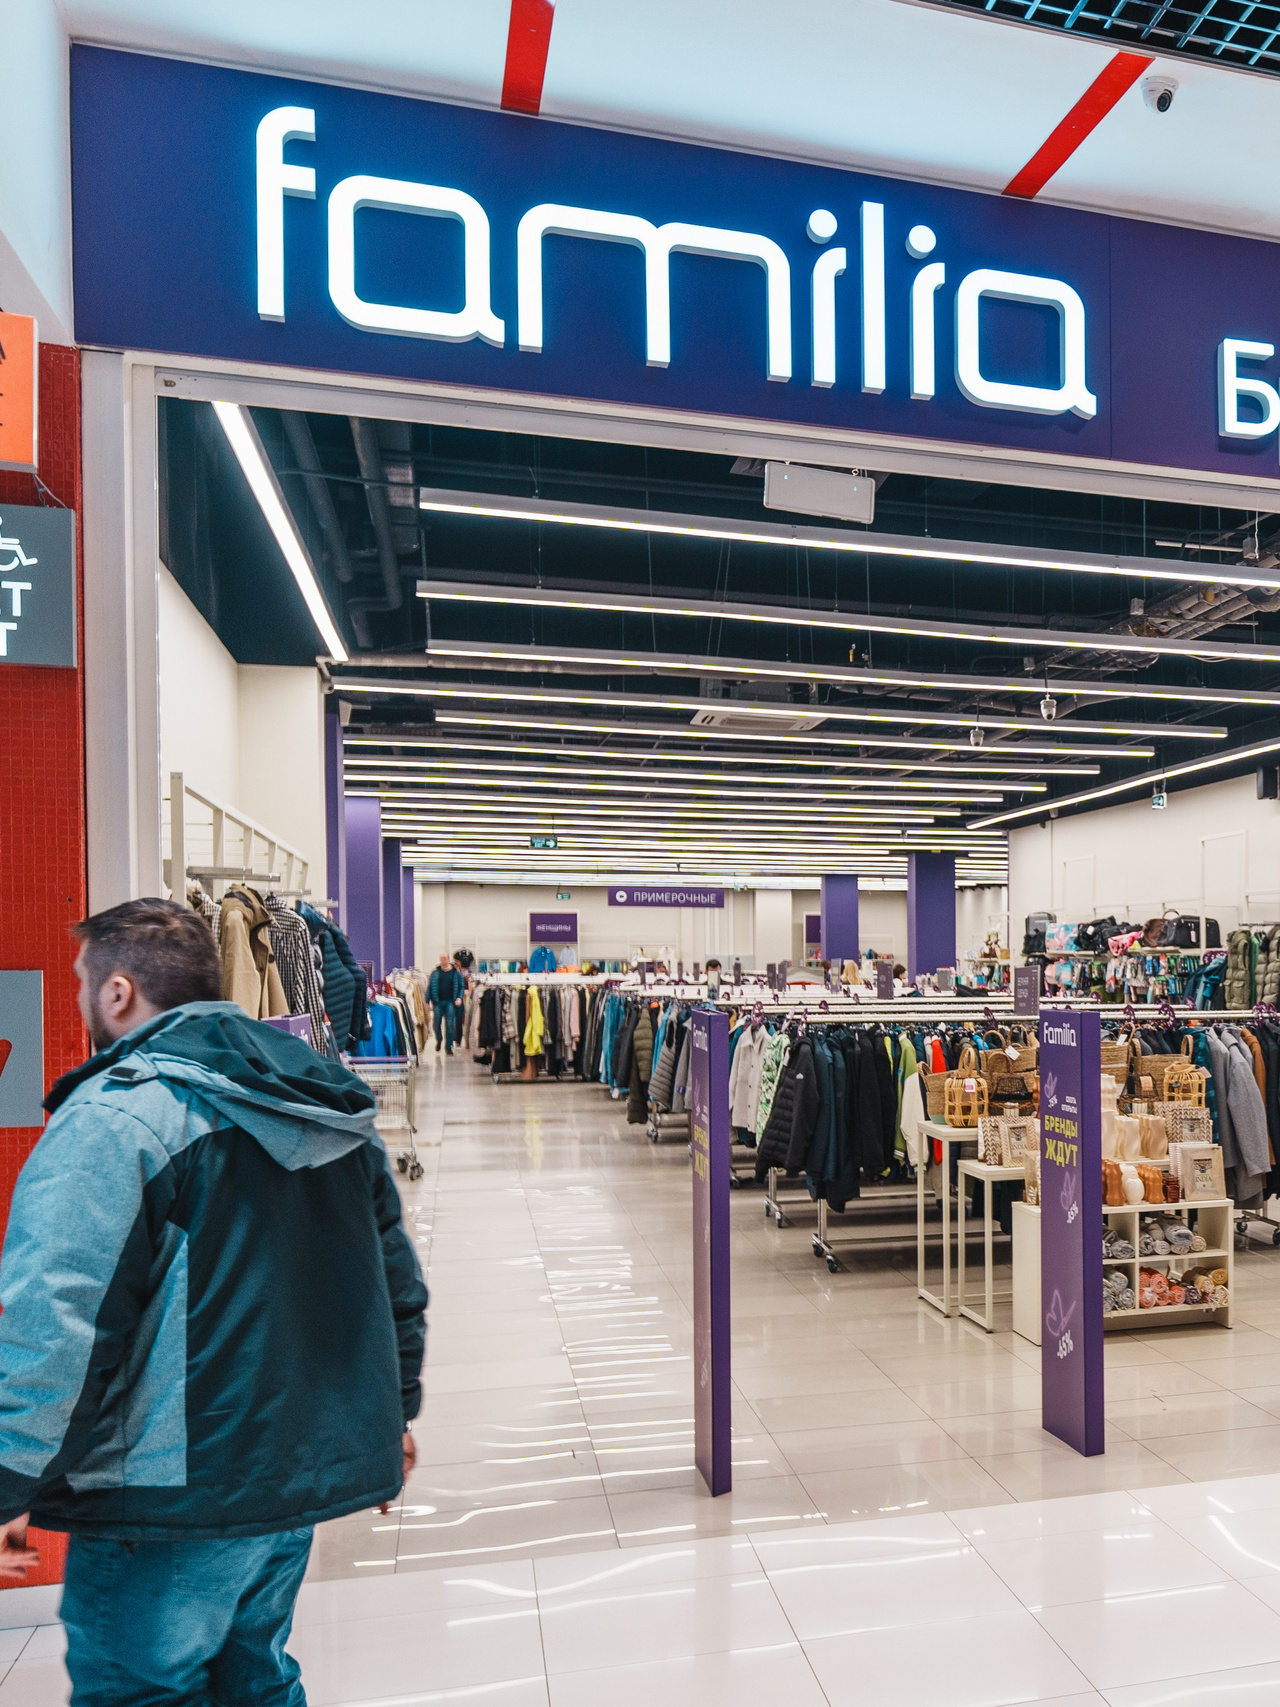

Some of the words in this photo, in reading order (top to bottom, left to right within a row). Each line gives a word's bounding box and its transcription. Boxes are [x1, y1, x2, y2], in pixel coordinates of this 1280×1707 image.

[256, 106, 1097, 419] familia
[633, 891, 717, 905] ПРИМЕРОЧНЫЕ
[1043, 1021, 1077, 1047] familia
[1044, 1114, 1078, 1138] БРЕНДЫ
[1045, 1137, 1078, 1167] ЖДУТ
